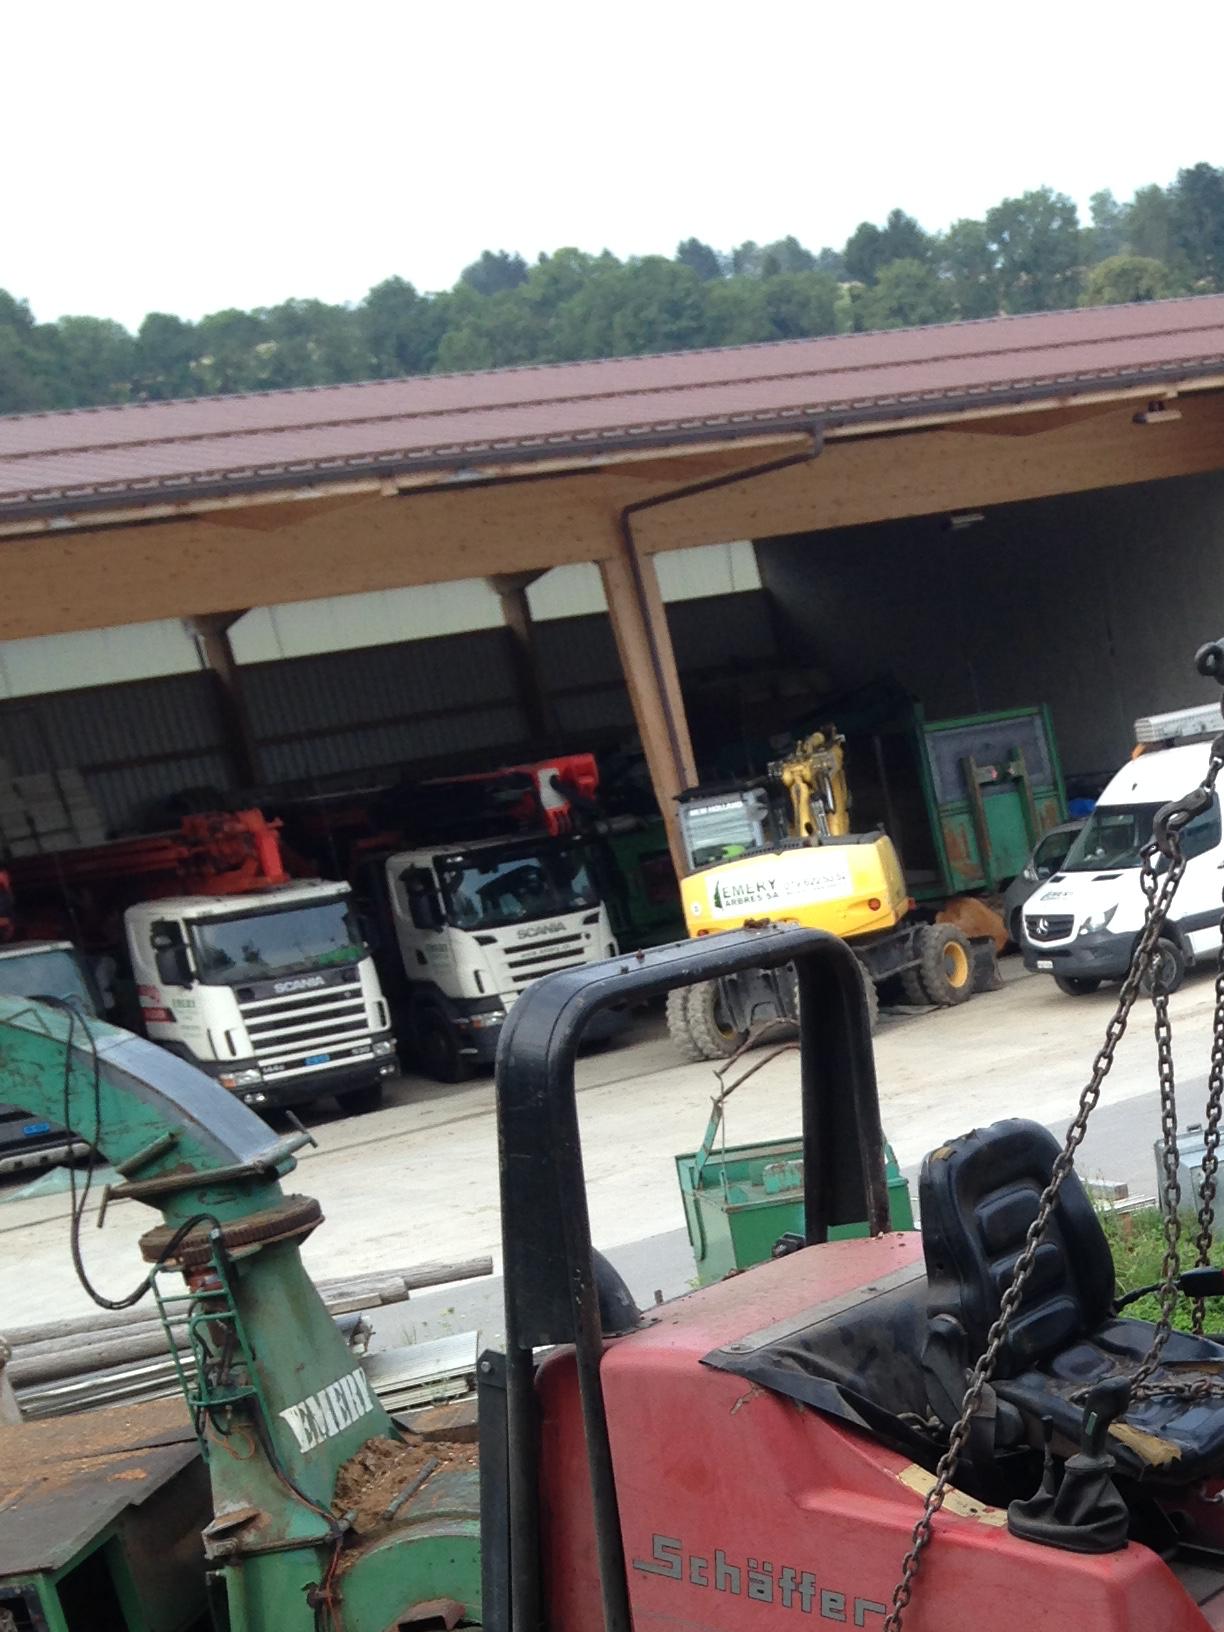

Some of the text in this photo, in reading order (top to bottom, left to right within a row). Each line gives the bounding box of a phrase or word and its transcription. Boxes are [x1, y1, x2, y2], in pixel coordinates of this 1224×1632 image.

[722, 880, 775, 898] EMERY
[726, 891, 779, 907] ARBRES SA
[517, 921, 567, 940] SCANIA
[273, 975, 326, 994] SCANIA
[631, 1533, 888, 1628] Schäffer
